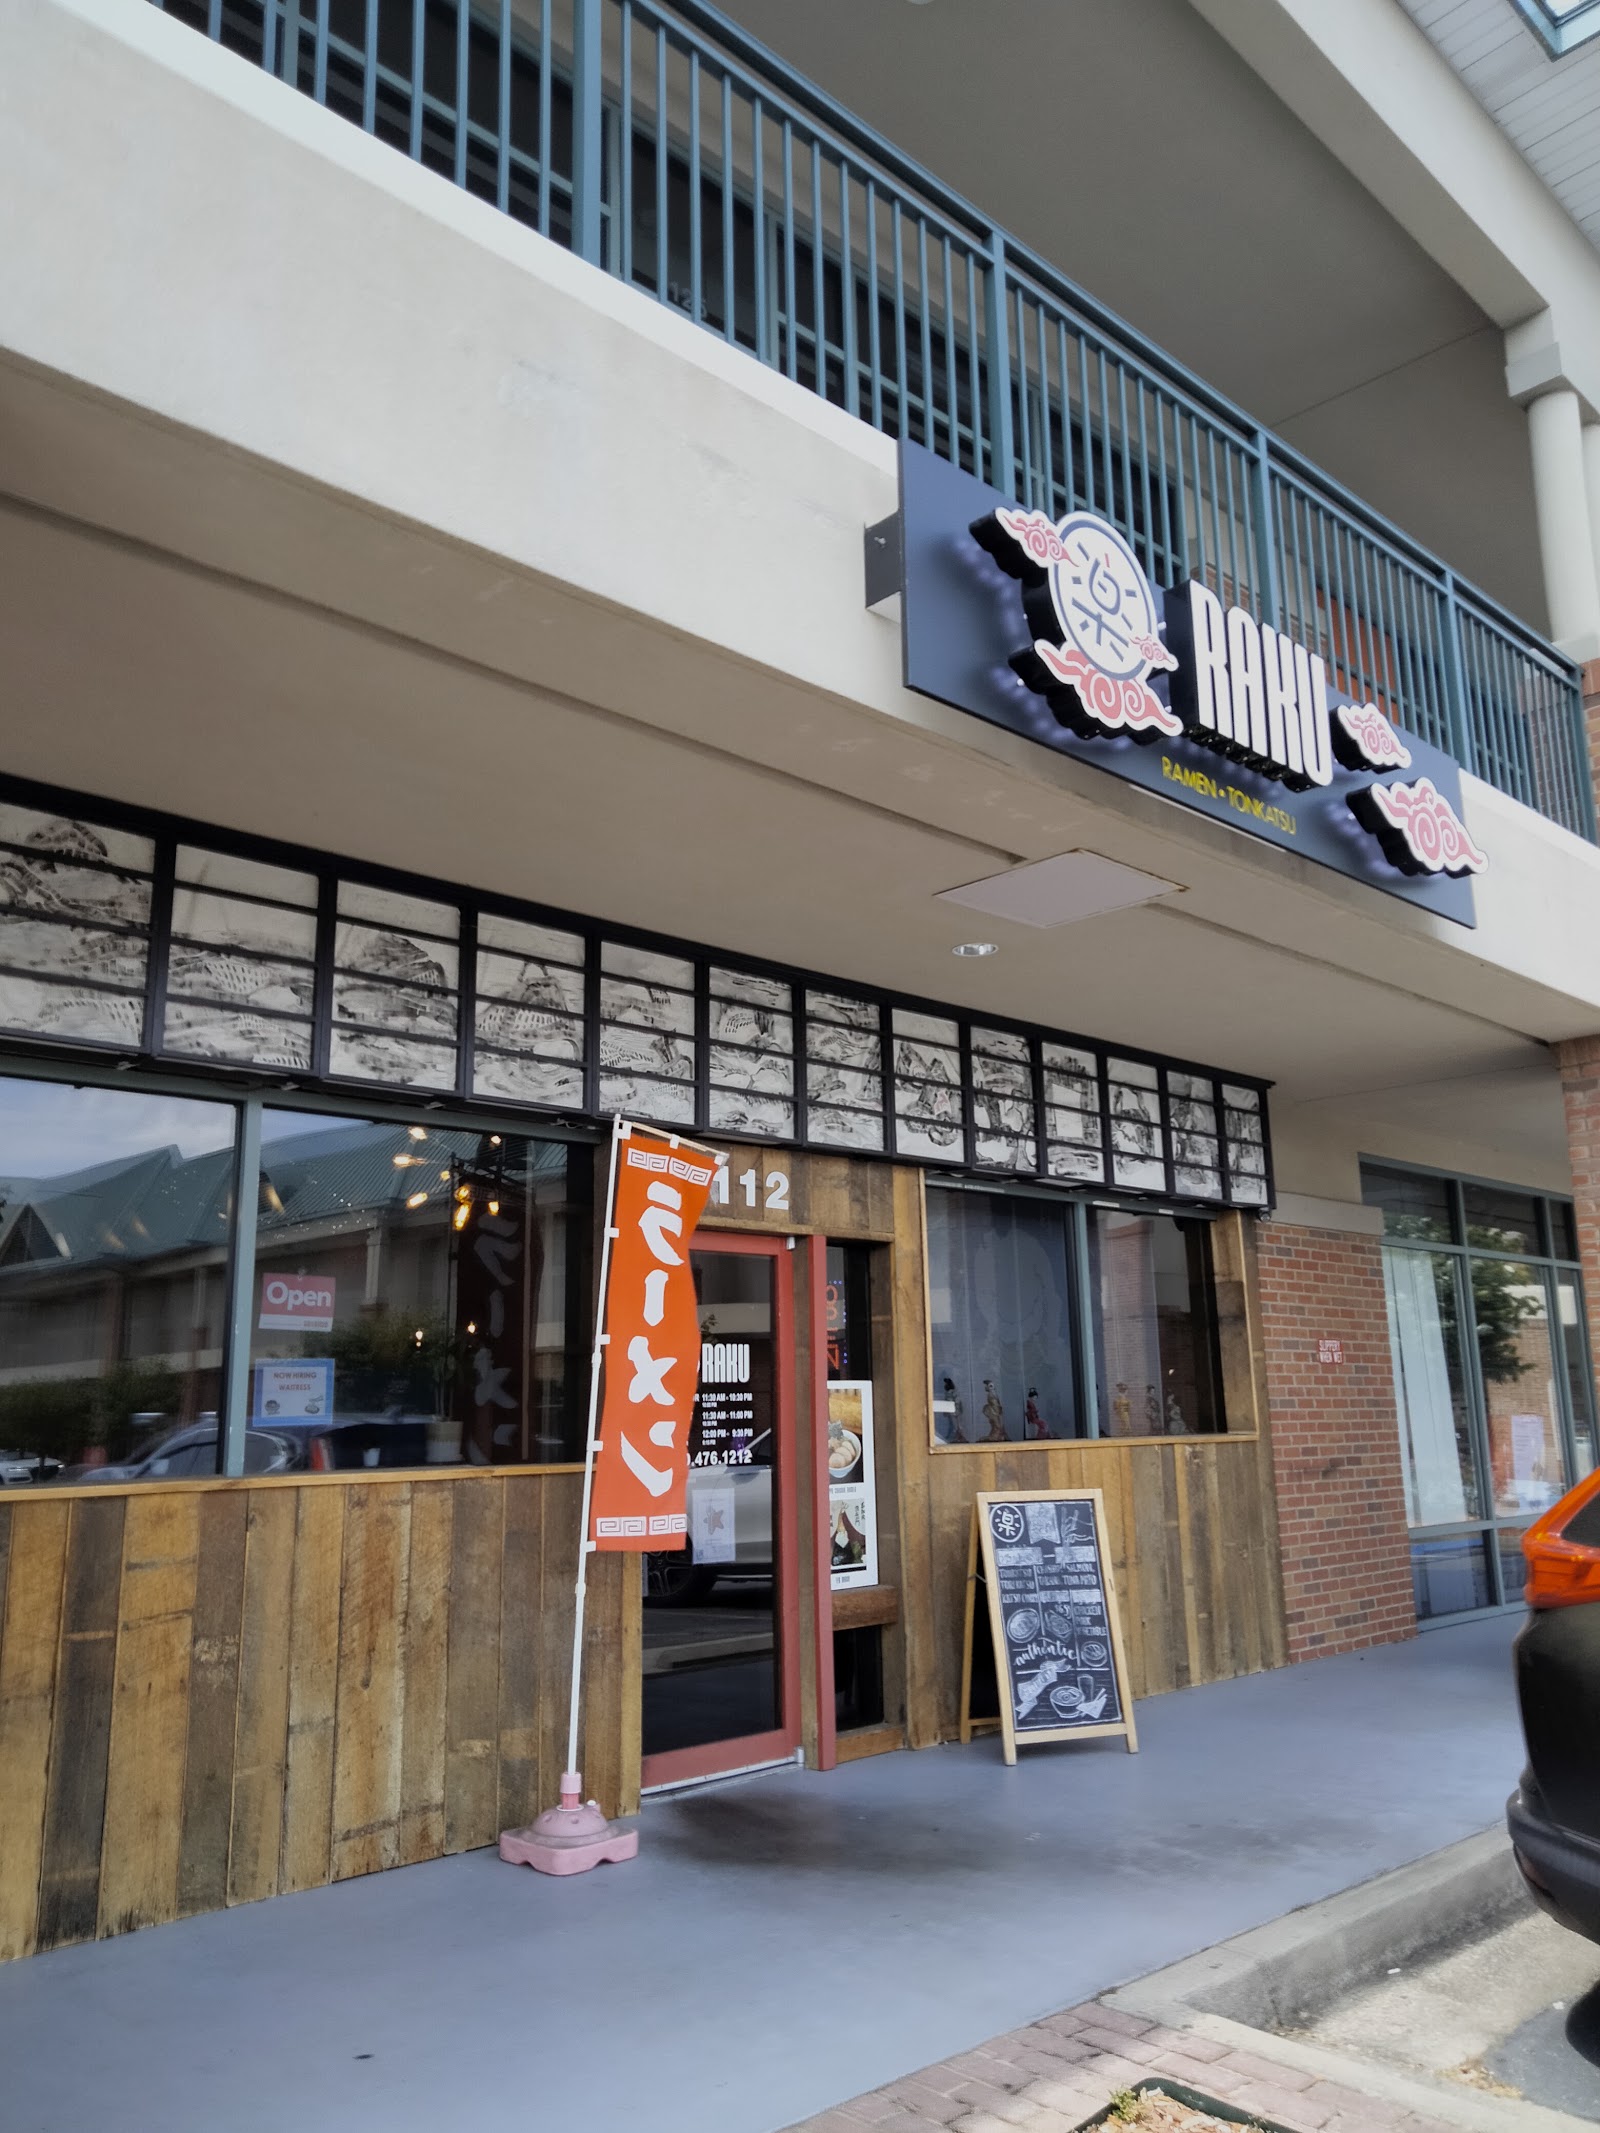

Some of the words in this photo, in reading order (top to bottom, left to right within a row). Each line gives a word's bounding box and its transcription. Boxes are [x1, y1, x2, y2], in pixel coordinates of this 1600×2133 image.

[1190, 579, 1333, 786] RAKU
[1162, 756, 1217, 798] RAMEN
[1226, 786, 1296, 835] TONKATSU
[712, 1166, 789, 1210] 112
[266, 1281, 332, 1311] Open
[273, 1372, 291, 1380] NOW
[702, 1343, 750, 1383] RAKU
[702, 1393, 716, 1402] 11:30
[716, 1393, 726, 1402] AM
[743, 1392, 753, 1401] PM
[702, 1411, 716, 1420] 11:30
[716, 1411, 726, 1420] AM
[743, 1410, 753, 1419] PM
[717, 1429, 726, 1438] PM
[743, 1428, 753, 1437] PM
[1013, 1638, 1078, 1666] authentic
